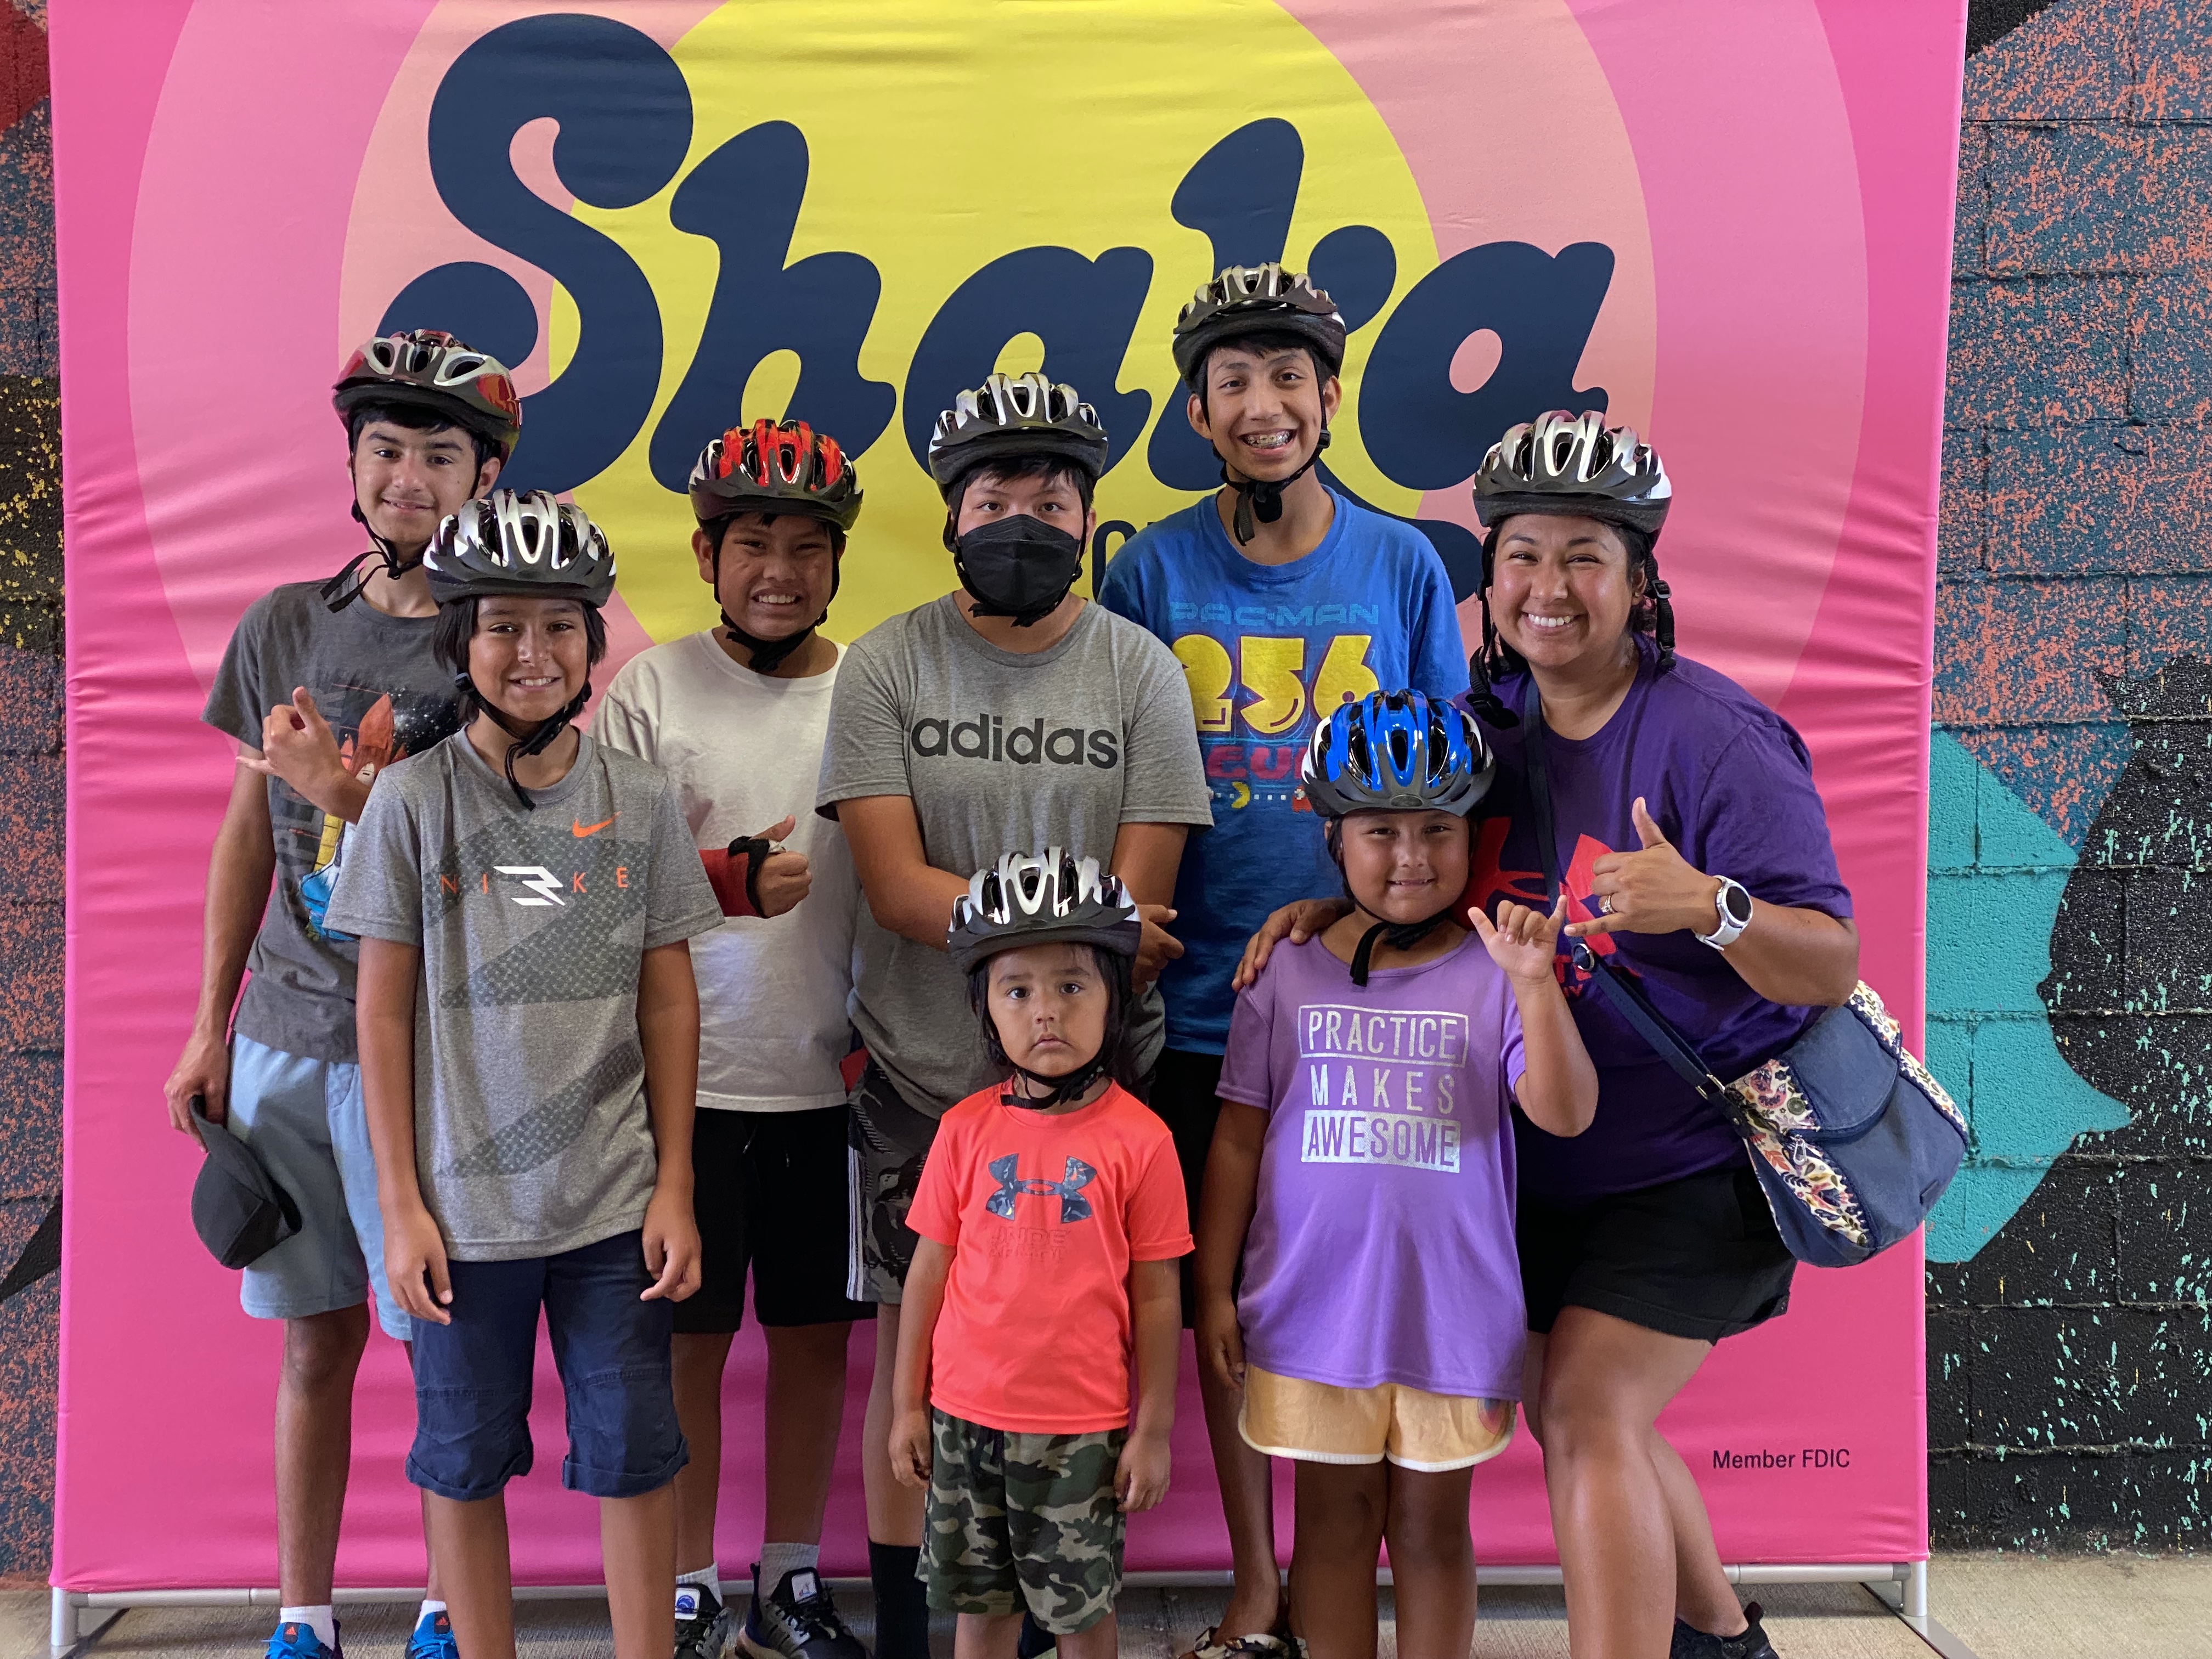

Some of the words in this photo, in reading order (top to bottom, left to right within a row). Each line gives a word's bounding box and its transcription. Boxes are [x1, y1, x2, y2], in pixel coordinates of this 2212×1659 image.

[376, 14, 1615, 606] Shaka
[1171, 635, 1380, 733] 256
[911, 713, 1118, 769] adidas
[1308, 1010, 1457, 1059] PRACTICE
[1310, 1064, 1456, 1114] MAKES
[1307, 1116, 1456, 1166] AWESOME
[1712, 1449, 1796, 1469] Member
[1802, 1448, 1850, 1468] FDIC
